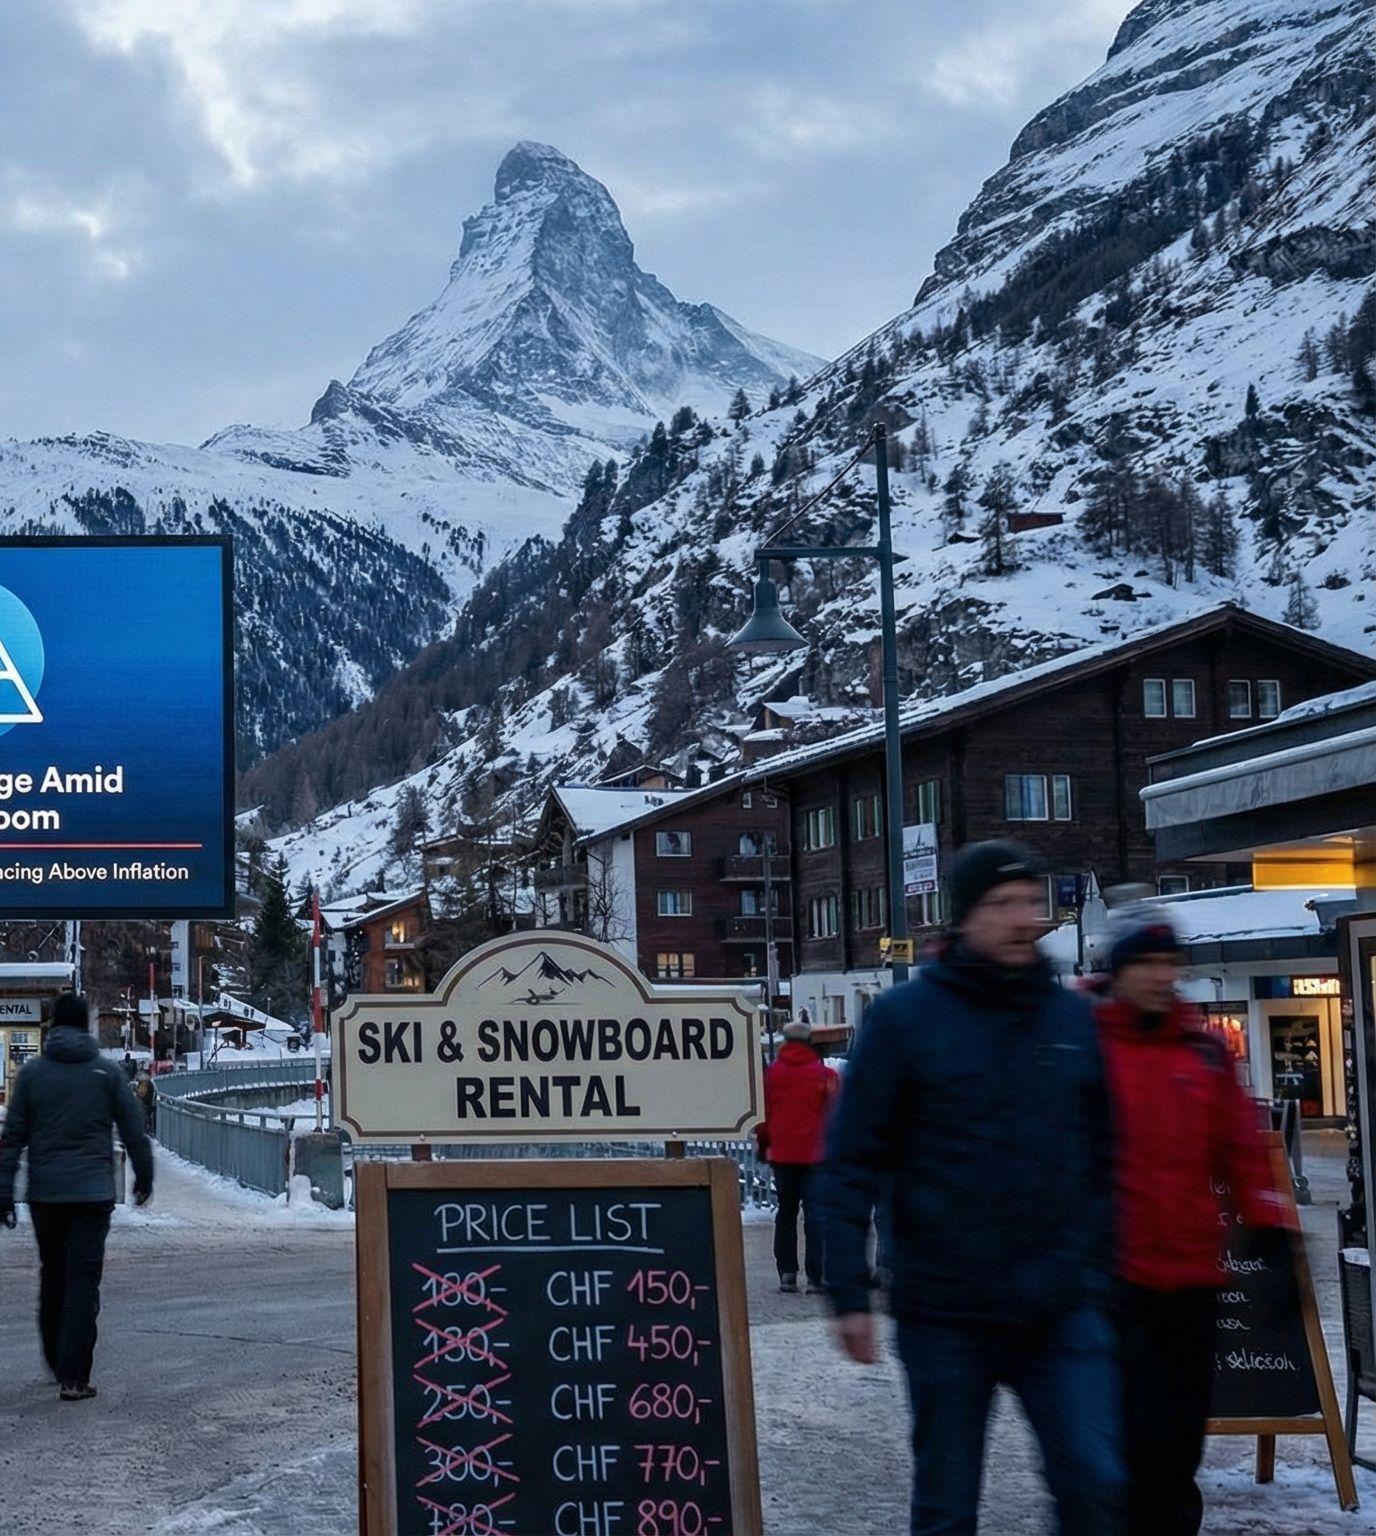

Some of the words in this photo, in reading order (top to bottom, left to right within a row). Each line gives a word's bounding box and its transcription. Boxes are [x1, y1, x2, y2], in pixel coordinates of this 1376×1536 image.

[39, 765, 123, 793] Amid
[48, 862, 108, 880] Above
[113, 862, 189, 880] Inflation
[358, 1020, 422, 1064] SKI
[436, 1020, 465, 1063] &
[477, 1017, 734, 1062] SNOWBOARD
[456, 1074, 641, 1119] RENTAL
[434, 1203, 552, 1242] PRICE
[570, 1203, 662, 1241] LIST
[546, 1270, 613, 1306] CHF
[626, 1270, 709, 1310] 150,-
[549, 1325, 615, 1362] CHF
[627, 1325, 711, 1366] 450,-
[551, 1383, 617, 1420] CHF
[629, 1383, 712, 1424] 680,-
[553, 1445, 621, 1482] CHF
[633, 1444, 720, 1486] 770,-
[555, 1501, 624, 1536] CHF
